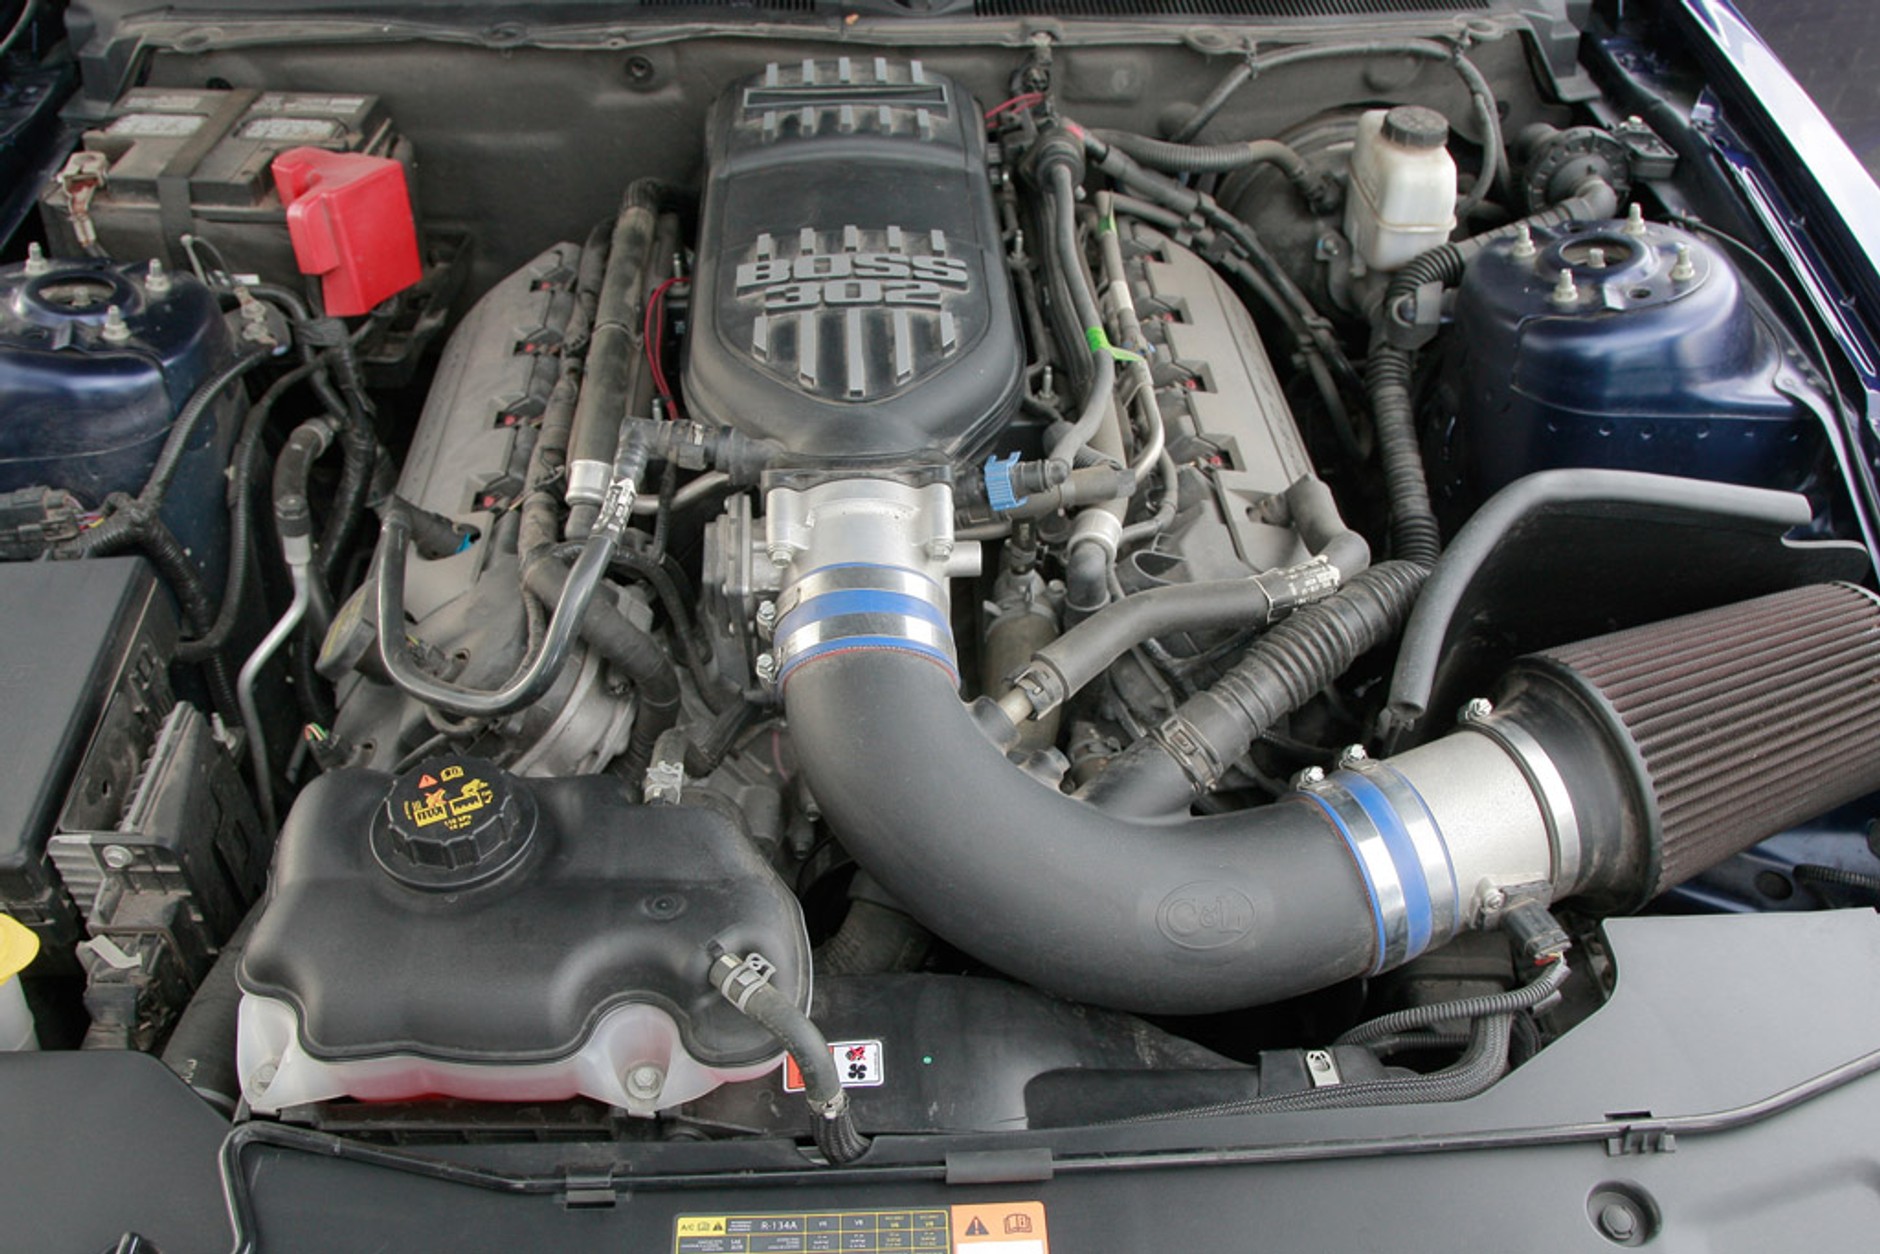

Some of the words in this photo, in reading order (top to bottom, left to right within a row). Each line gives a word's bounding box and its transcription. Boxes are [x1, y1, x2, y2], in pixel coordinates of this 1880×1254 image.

[736, 252, 969, 296] BOSS
[764, 279, 943, 312] 302
[1165, 896, 1245, 938] C&L
[760, 1220, 798, 1231] R-134A
